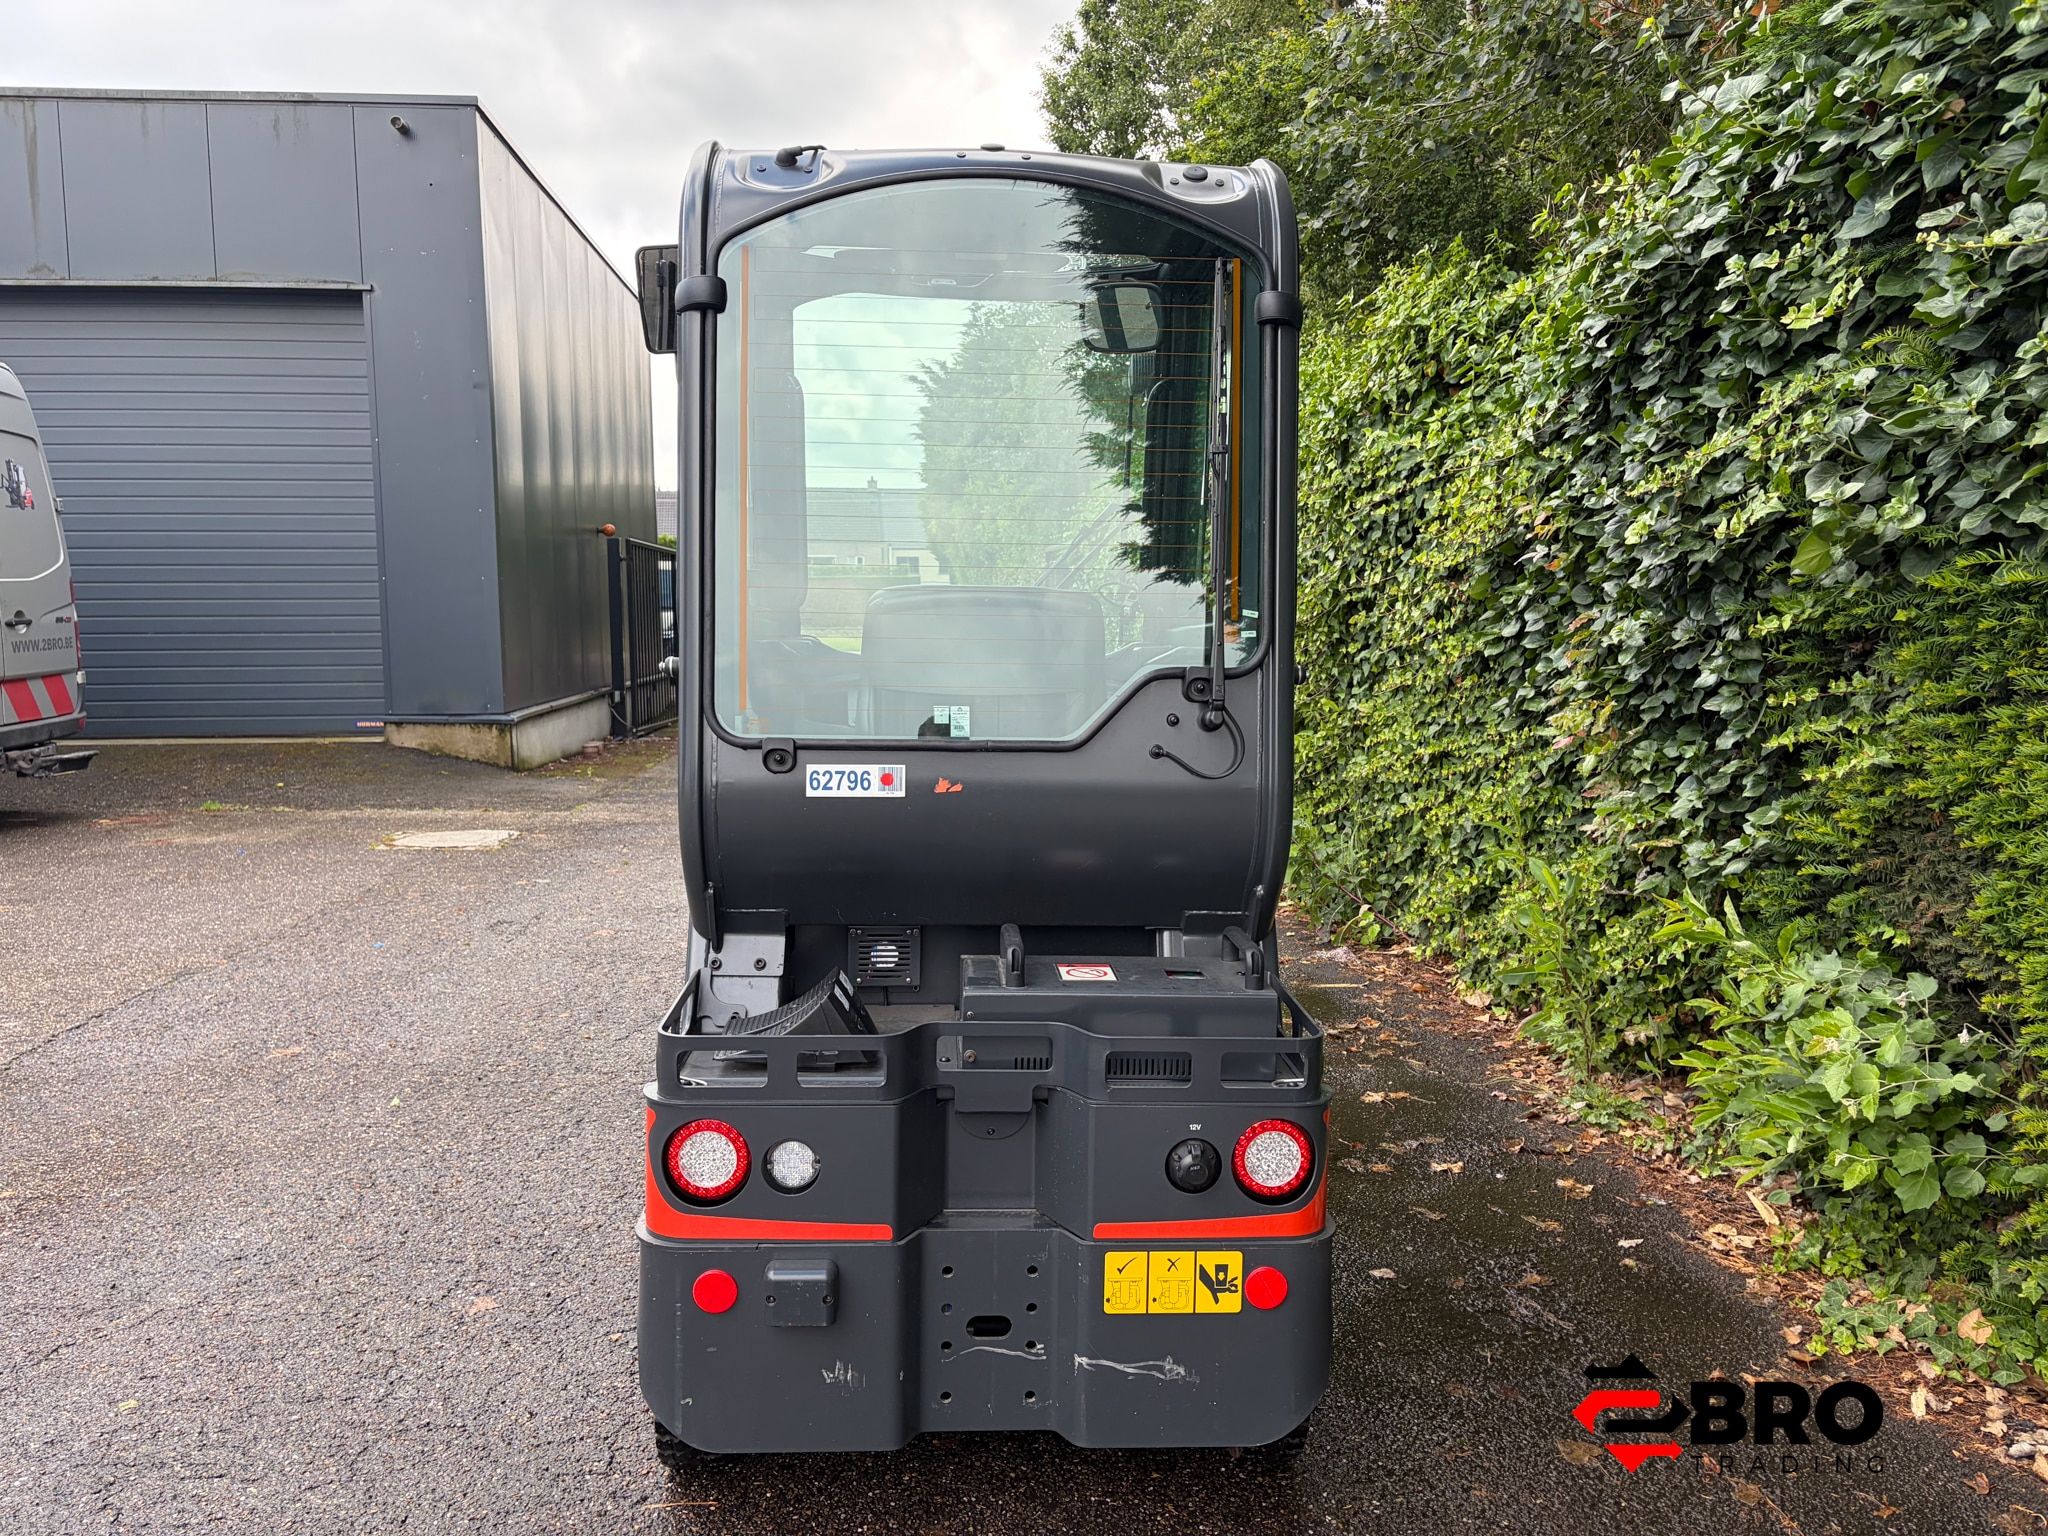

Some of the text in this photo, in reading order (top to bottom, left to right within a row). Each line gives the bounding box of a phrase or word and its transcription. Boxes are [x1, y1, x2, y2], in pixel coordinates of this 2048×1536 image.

[11, 637, 73, 653] WWW.2BRO.BE
[809, 770, 872, 791] 62796
[1189, 1123, 1202, 1131] 12V
